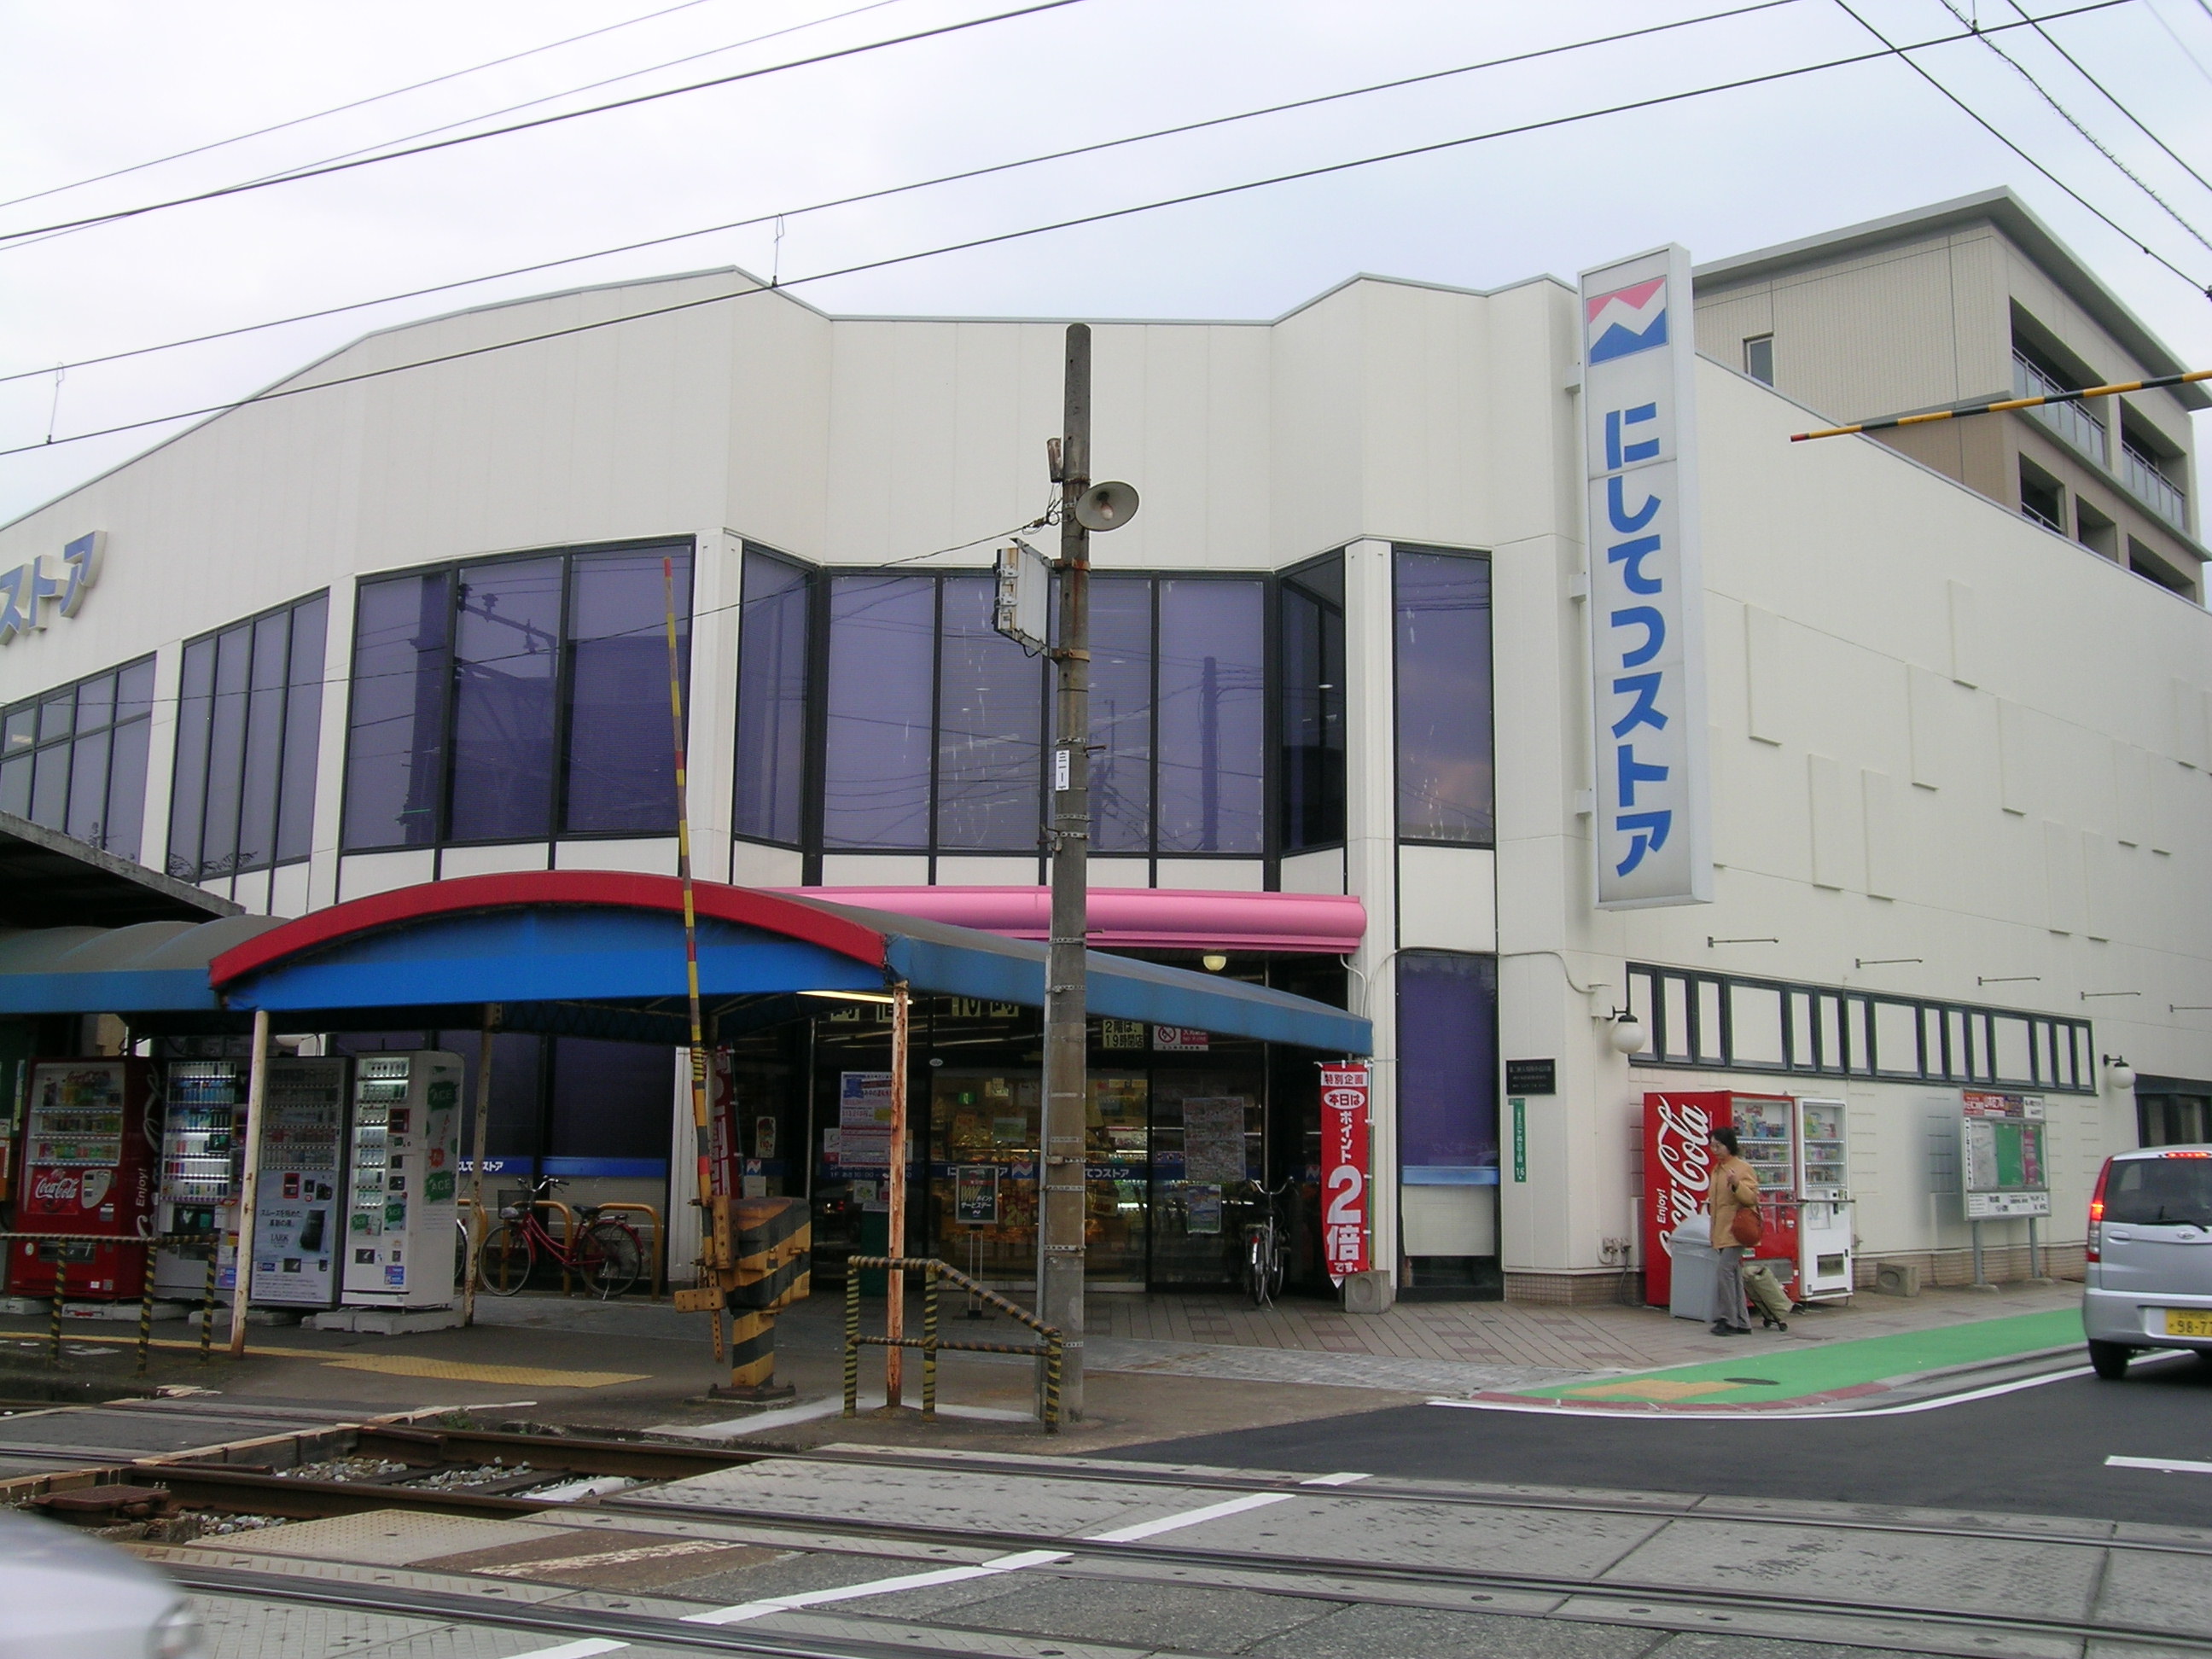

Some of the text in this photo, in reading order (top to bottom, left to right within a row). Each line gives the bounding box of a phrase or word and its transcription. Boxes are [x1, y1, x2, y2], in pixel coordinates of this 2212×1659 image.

[1605, 401, 1673, 877] にしてつストア
[1324, 1074, 1364, 1085] 特別企画
[1329, 1093, 1360, 1106] 本日は
[1340, 1110, 1353, 1164] ポイント
[136, 1167, 148, 1208] Enjoy!
[1656, 1187, 1667, 1225] Enjoy!
[2177, 1319, 2212, 1334] 98-7
